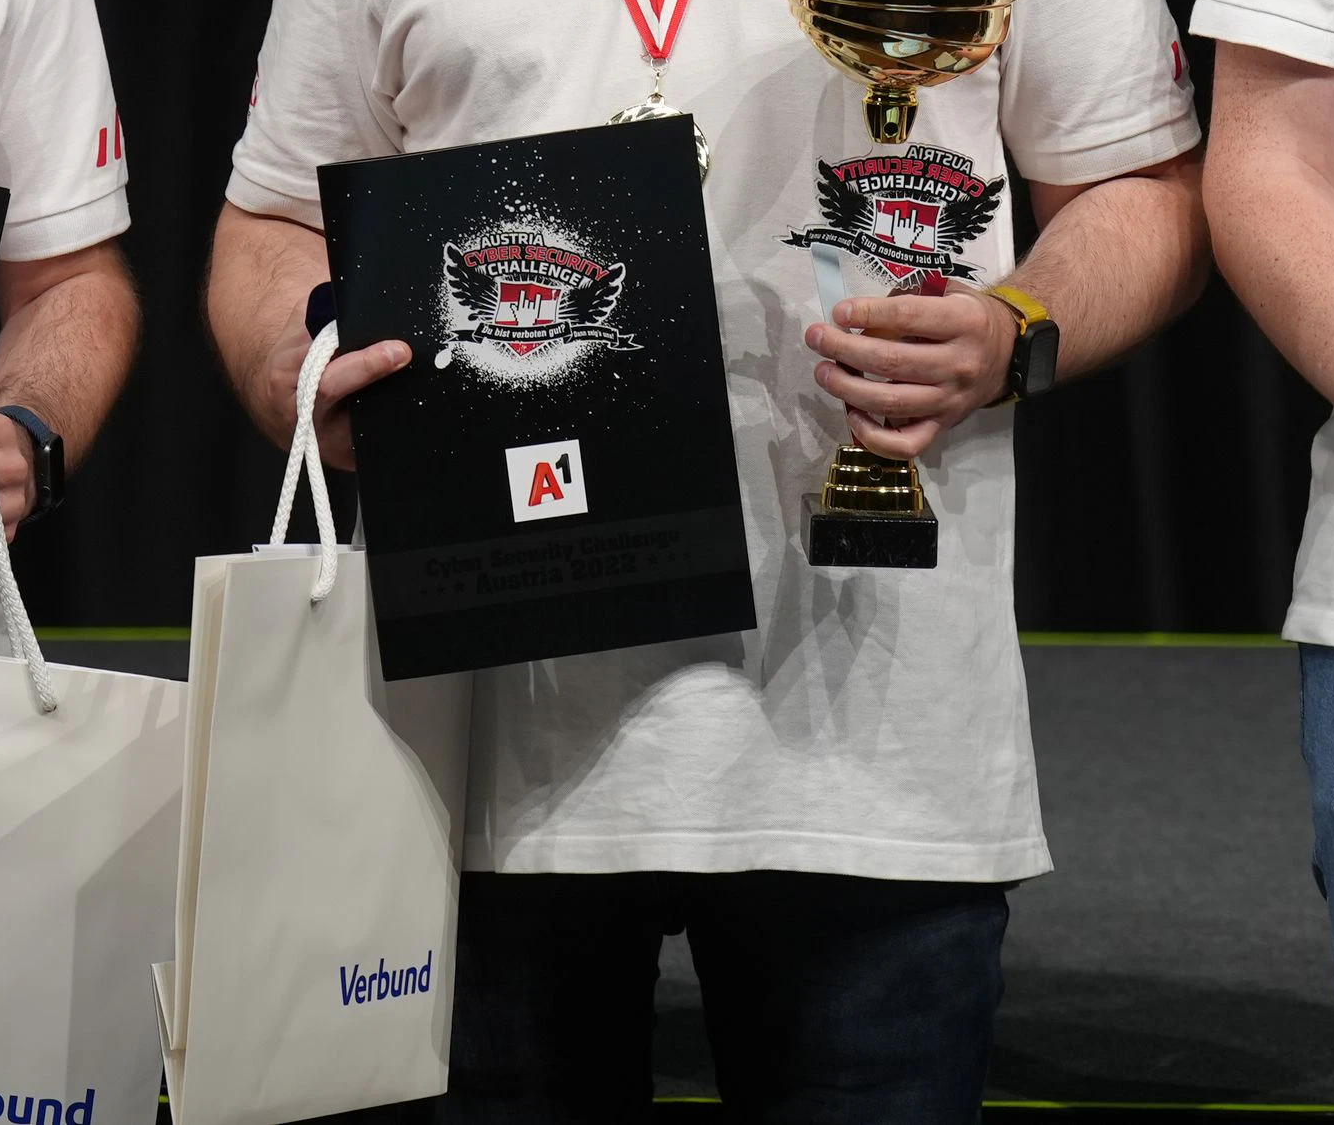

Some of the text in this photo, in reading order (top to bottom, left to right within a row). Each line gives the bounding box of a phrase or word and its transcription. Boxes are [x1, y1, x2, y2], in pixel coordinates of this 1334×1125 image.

[481, 233, 544, 249] AUSTRIA
[463, 245, 611, 282] CYBER SECURITY
[488, 260, 583, 288] CHALLENGE
[481, 324, 566, 340] Du bist verboten gut?
[528, 453, 572, 507] A1
[339, 949, 433, 1007] Verbund
